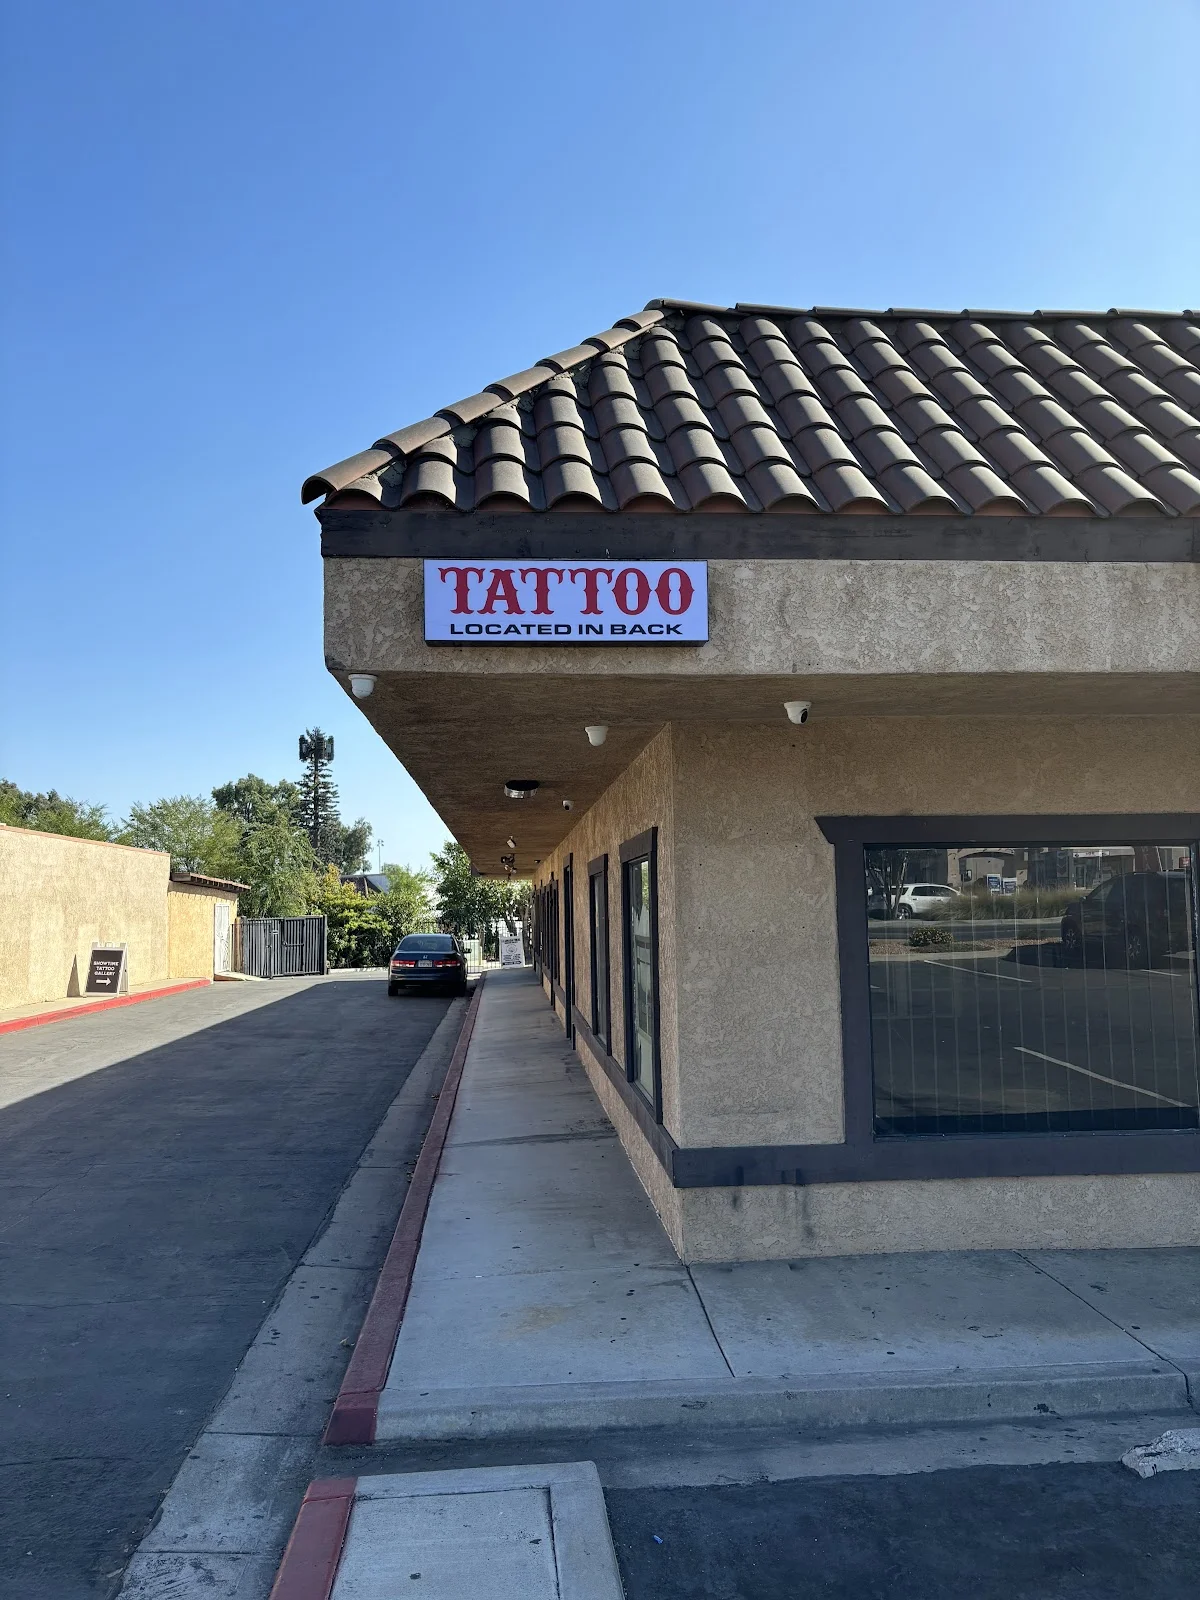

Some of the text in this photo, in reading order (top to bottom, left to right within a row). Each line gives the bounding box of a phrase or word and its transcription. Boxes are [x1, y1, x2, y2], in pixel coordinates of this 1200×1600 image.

[438, 567, 695, 615] TATTOO
[450, 623, 683, 635] LOCATED IN BACK
